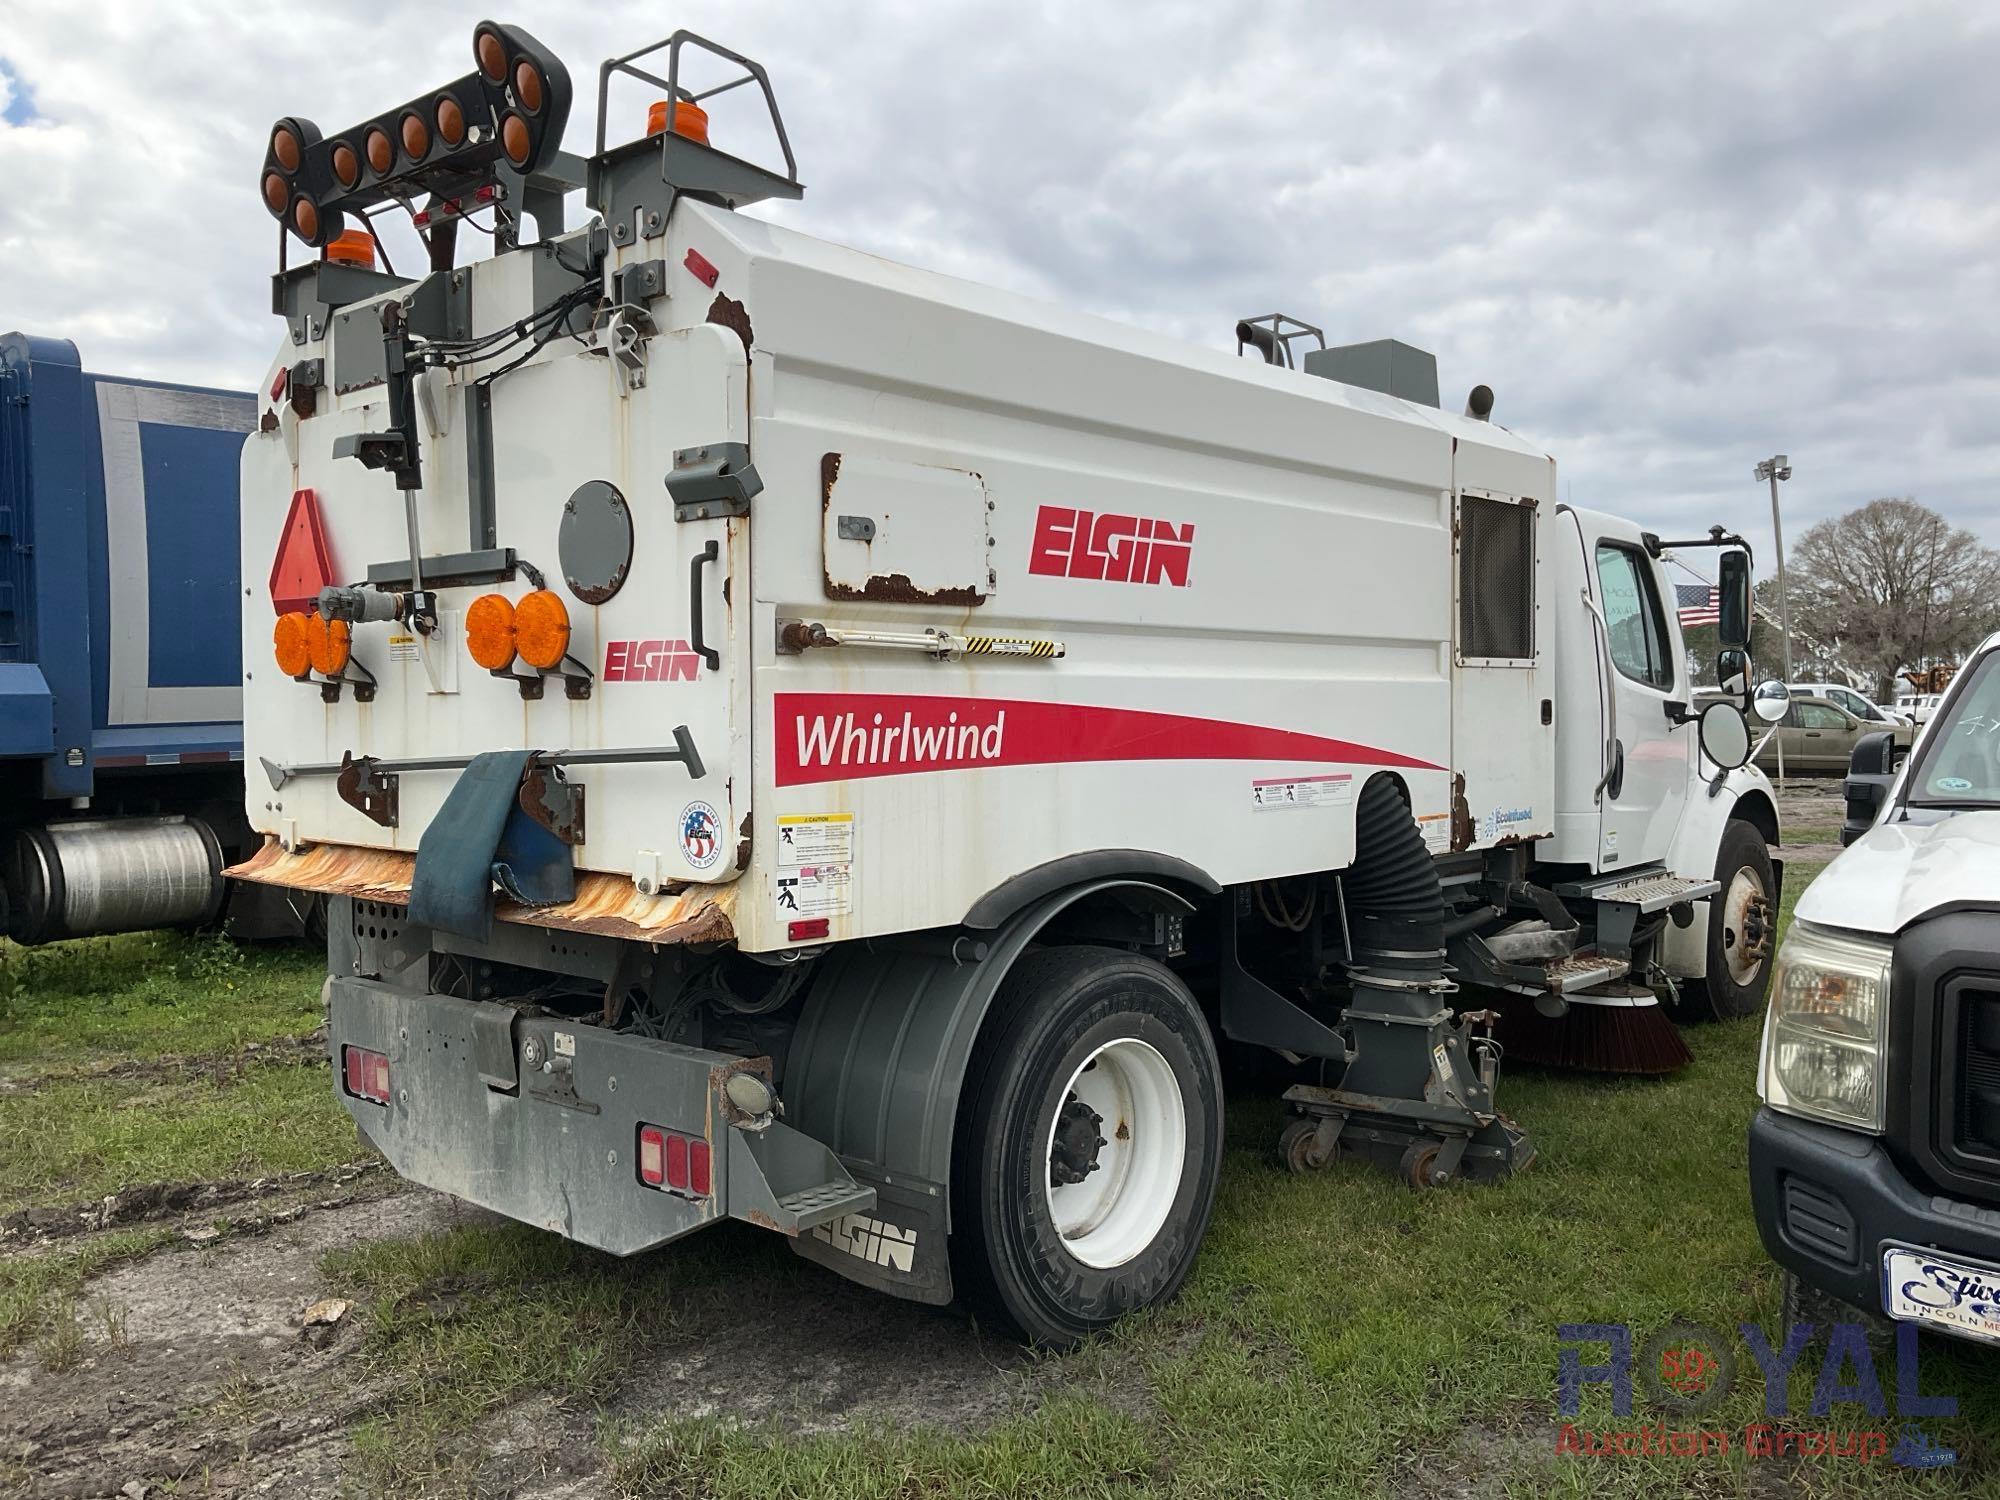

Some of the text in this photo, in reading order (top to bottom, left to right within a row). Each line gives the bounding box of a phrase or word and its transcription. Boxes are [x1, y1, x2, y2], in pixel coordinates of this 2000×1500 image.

[1028, 504, 1195, 588] ELGIN
[603, 639, 702, 682] ELGIN
[796, 710, 1005, 767] Whirlwind
[1903, 1303, 1978, 1326] LINCOLN
